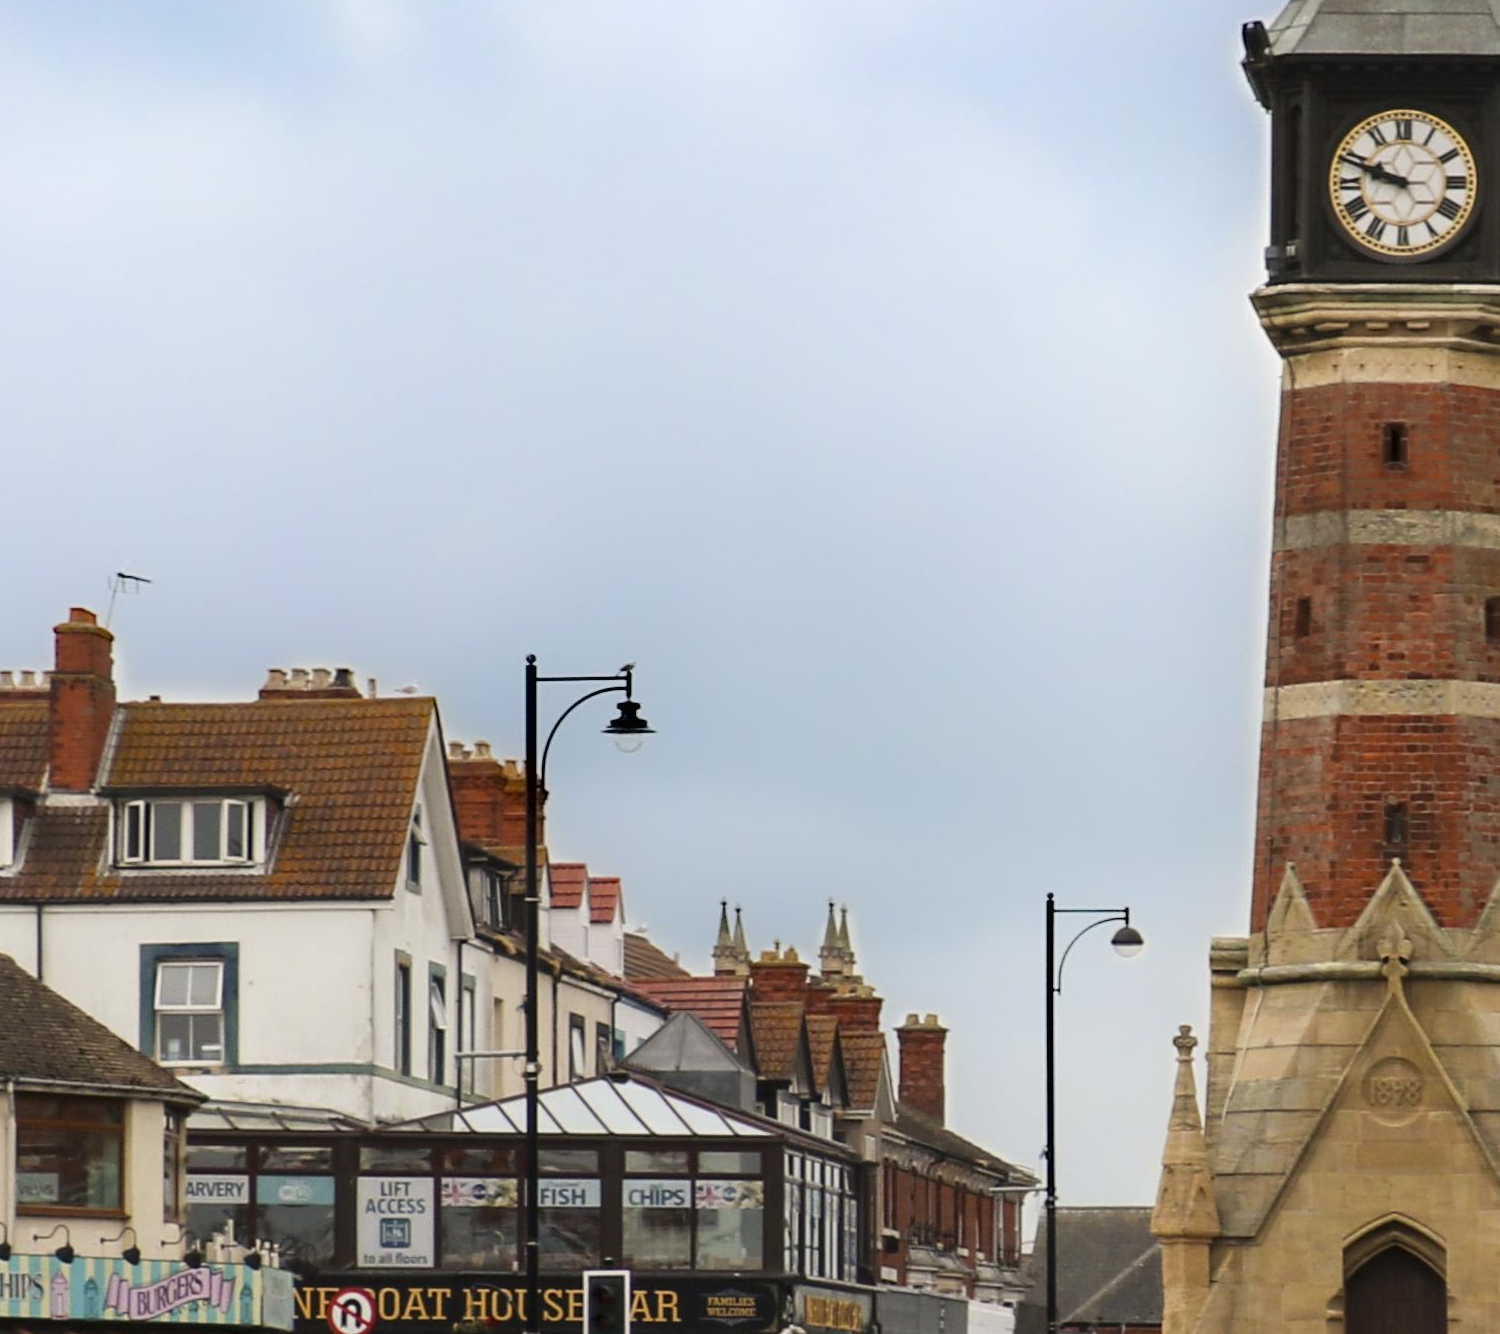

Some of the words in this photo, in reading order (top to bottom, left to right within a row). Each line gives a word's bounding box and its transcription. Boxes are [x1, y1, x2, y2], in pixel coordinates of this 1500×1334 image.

[1371, 1076, 1420, 1106] 1898
[185, 1181, 245, 1198] ARVERY
[380, 1181, 411, 1196] LIFT
[540, 1188, 586, 1205] FISH
[628, 1188, 685, 1206] CHIPS
[365, 1198, 426, 1214] ACCESS
[136, 1271, 204, 1316] BURGERS
[706, 1296, 756, 1306] FAMILIES
[370, 1287, 451, 1321] OAT
[630, 1290, 682, 1323] AR
[706, 1307, 757, 1317] WELCOME
